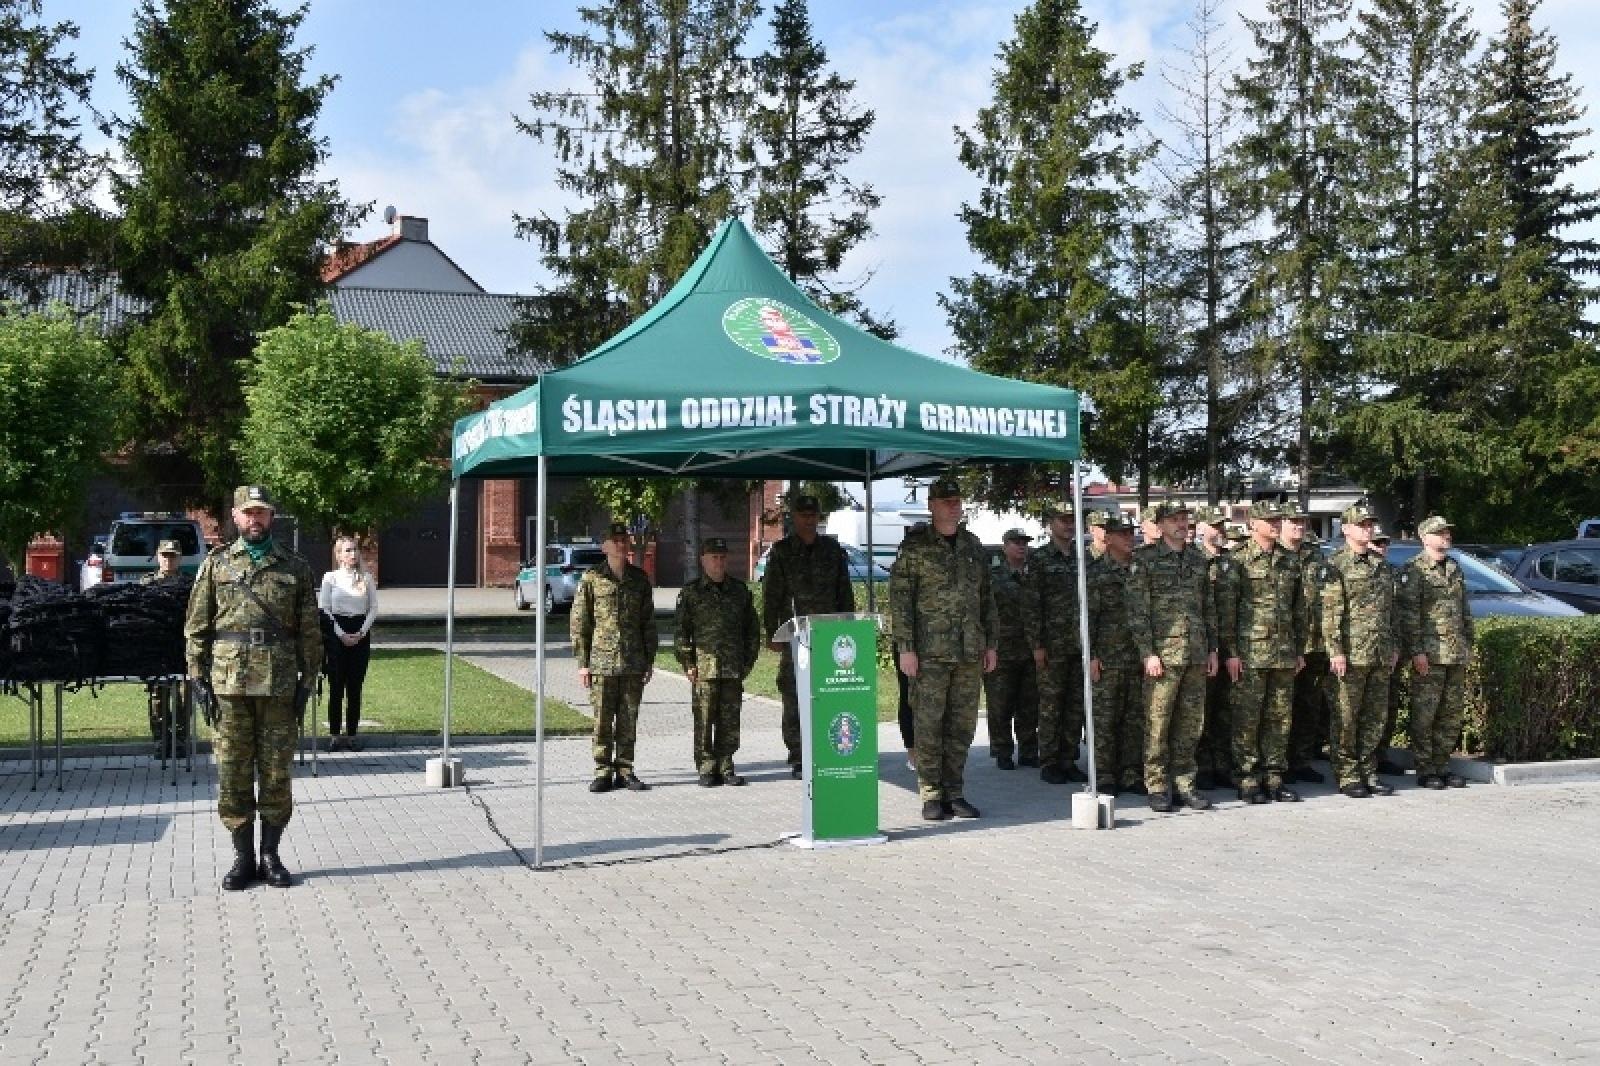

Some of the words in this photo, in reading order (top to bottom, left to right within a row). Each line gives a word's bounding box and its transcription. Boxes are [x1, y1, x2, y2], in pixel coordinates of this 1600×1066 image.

[562, 394, 667, 436] ŚLĄSKI
[681, 395, 797, 429] ODDZIAŁ
[809, 393, 907, 429] STRAŻY
[919, 402, 1067, 438] GRANICZNEJ
